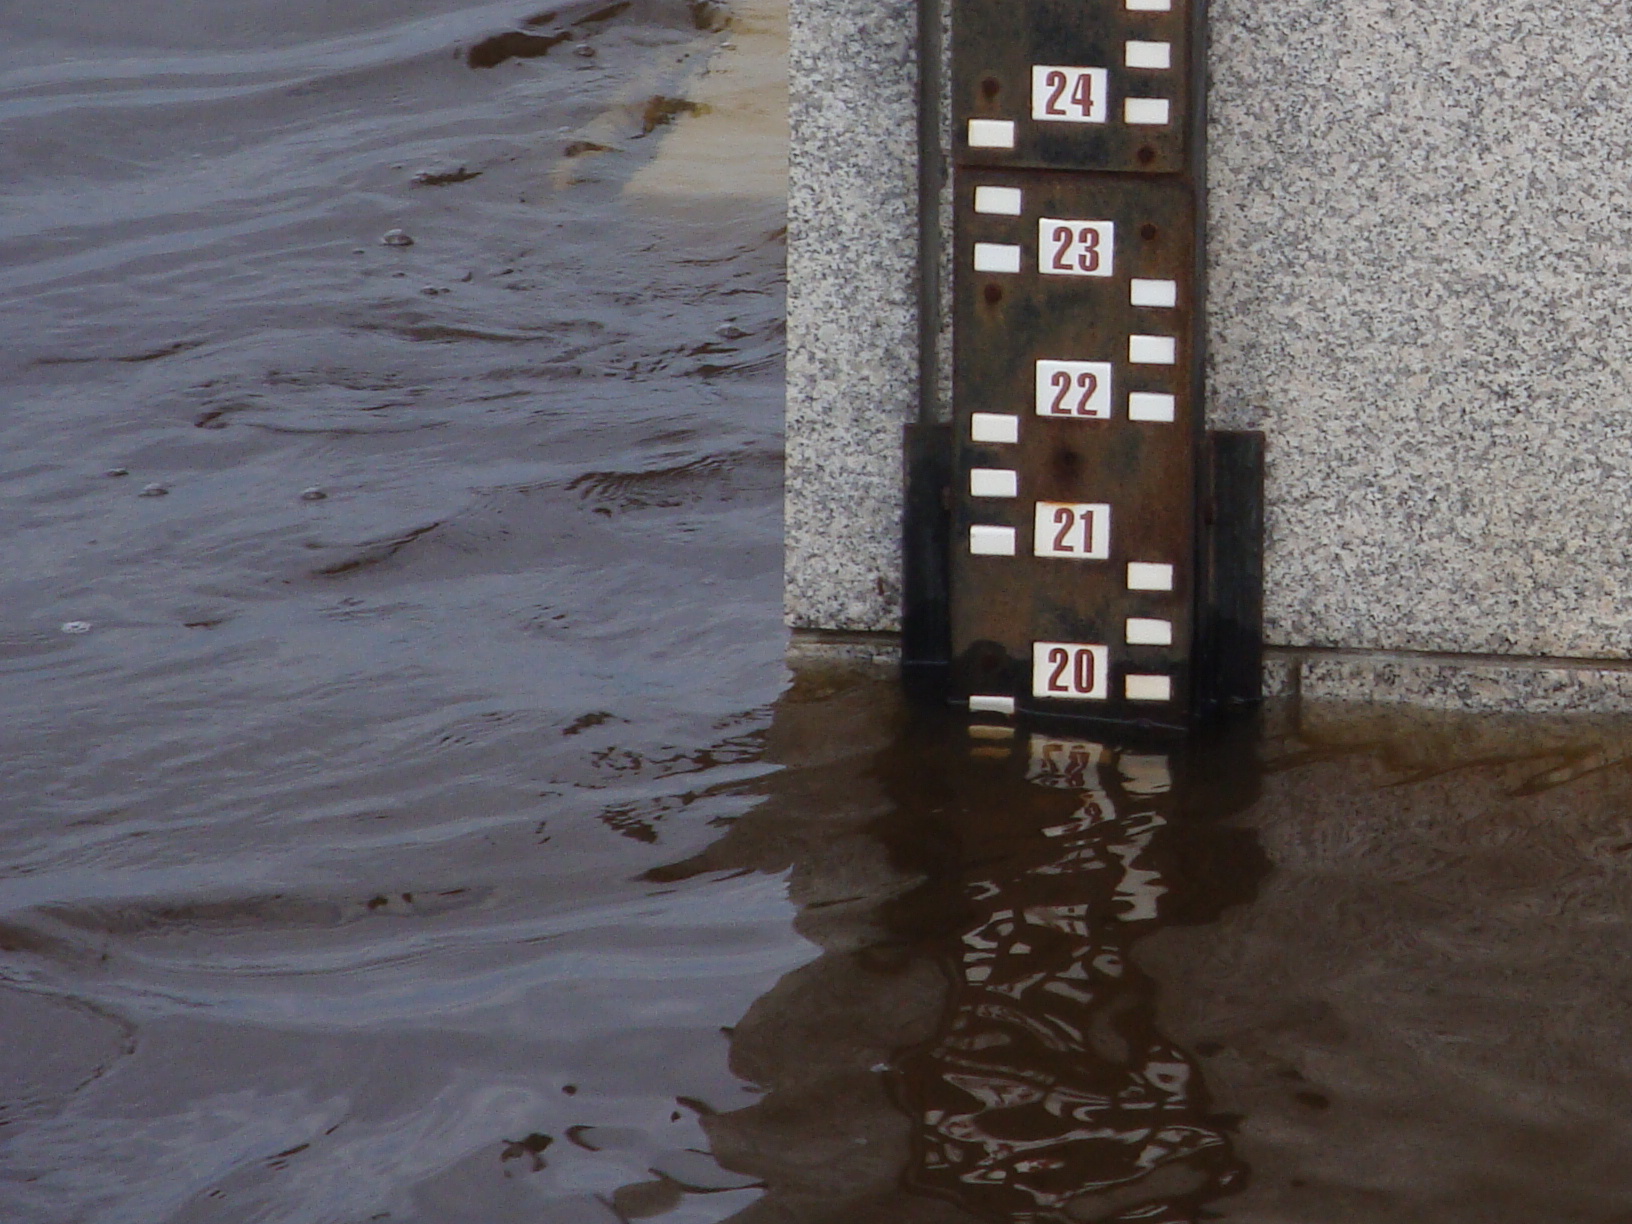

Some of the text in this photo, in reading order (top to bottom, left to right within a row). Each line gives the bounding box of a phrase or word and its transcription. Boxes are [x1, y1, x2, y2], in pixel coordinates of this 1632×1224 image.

[1045, 71, 1093, 117] 24
[1052, 226, 1100, 272] 23
[1050, 370, 1099, 417] 22
[1053, 507, 1094, 554] 21
[1047, 648, 1095, 694] 20
